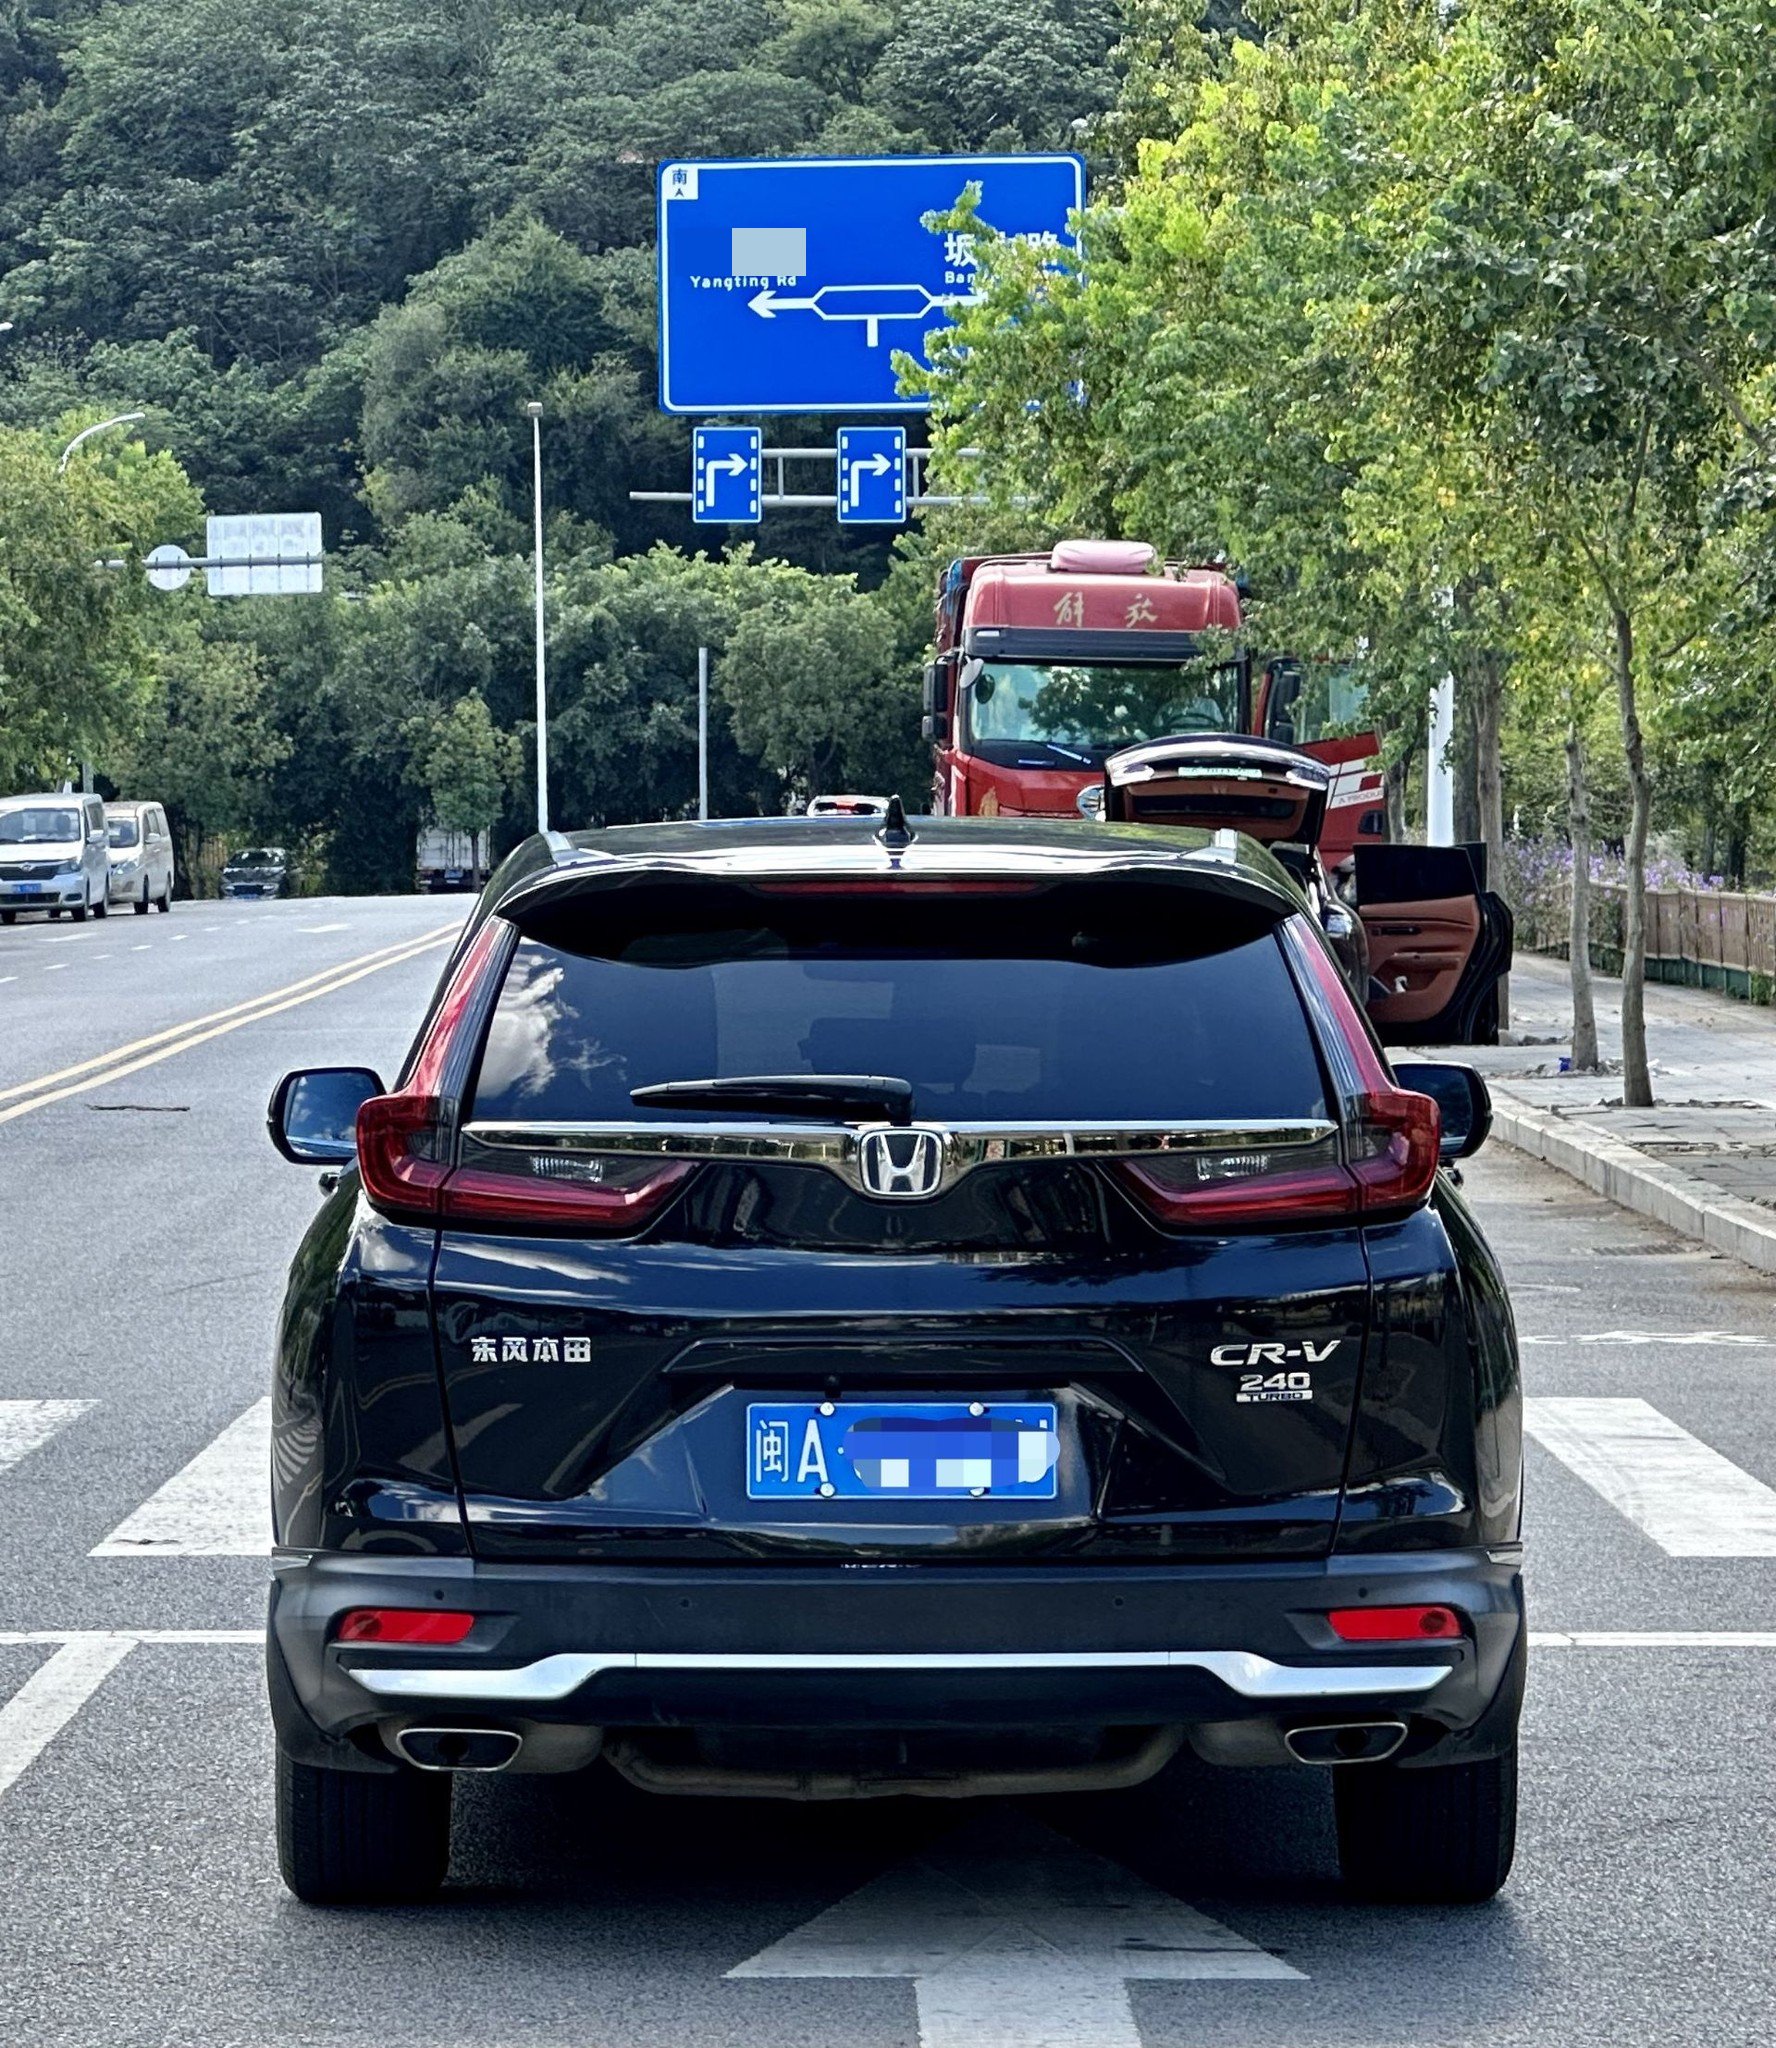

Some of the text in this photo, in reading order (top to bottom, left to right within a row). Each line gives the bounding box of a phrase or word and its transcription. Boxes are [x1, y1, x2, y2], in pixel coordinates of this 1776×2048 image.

[672, 168, 688, 185] 南
[690, 275, 797, 291] Yangting Rd
[470, 1336, 592, 1363] 东风本田
[1210, 1339, 1342, 1366] CR-V
[1240, 1371, 1311, 1391] 240
[1244, 1392, 1306, 1402] TURBO
